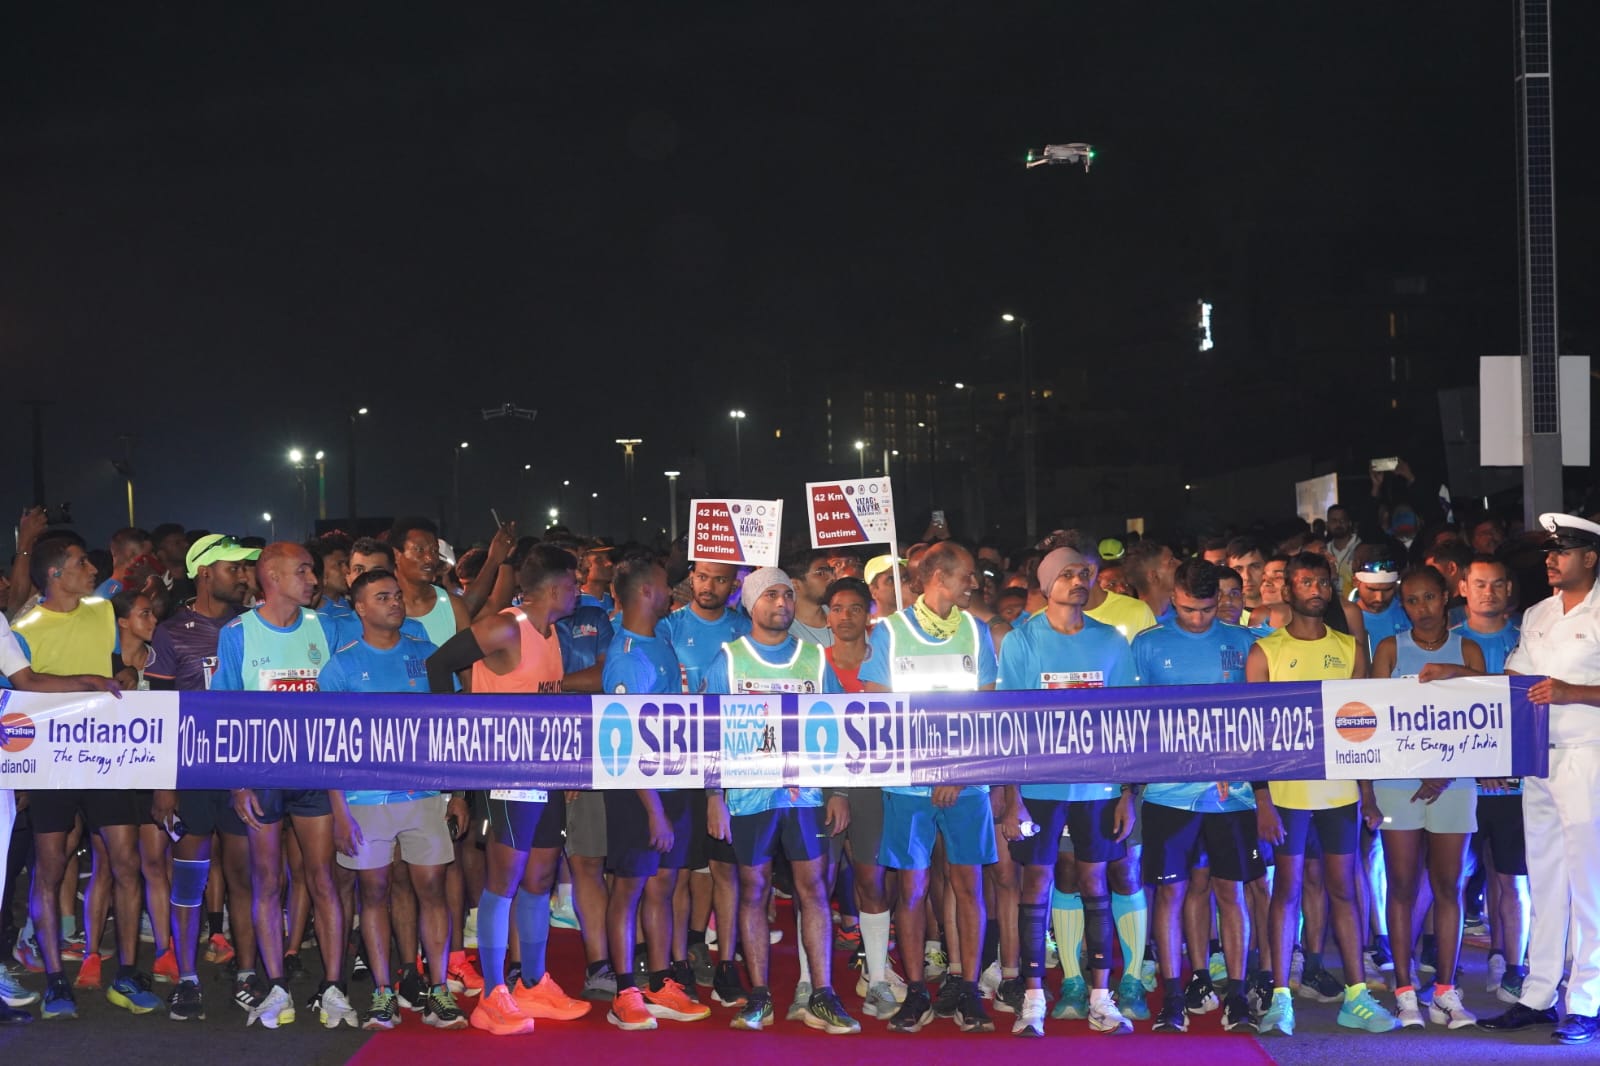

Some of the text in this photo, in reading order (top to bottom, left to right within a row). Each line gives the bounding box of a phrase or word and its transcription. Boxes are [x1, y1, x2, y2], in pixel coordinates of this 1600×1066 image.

[814, 492, 844, 502] 42 Km
[697, 508, 729, 517] 42 Km
[816, 512, 829, 522] 04
[831, 511, 851, 521] Hrs
[696, 532, 710, 541] 30
[711, 533, 735, 542] mins
[697, 522, 729, 532] 04 Hrs
[818, 529, 857, 539] Guntime
[696, 544, 735, 554] Guntime
[723, 703, 766, 729] VIZAG
[1389, 703, 1503, 732] IndianOil
[49, 717, 163, 744] IndianOil
[216, 719, 297, 764] EDITION
[305, 718, 363, 763] VIZAG
[370, 718, 421, 763] NAVY
[429, 717, 534, 763] MARATHON
[540, 717, 582, 762] 2025
[638, 702, 698, 777] SBI
[844, 701, 904, 776] SBI
[947, 710, 1028, 757] EDITION
[1034, 709, 1093, 755] VIZAG
[1101, 708, 1151, 754] NAVY
[1158, 707, 1265, 753] MARATHON
[1271, 706, 1314, 752] 2025
[724, 731, 764, 760] NAVY
[1335, 749, 1381, 765] IndianOil
[1396, 734, 1498, 761] The Energy of India
[0, 759, 36, 774] dianOil
[53, 748, 156, 774] The Energy of India
